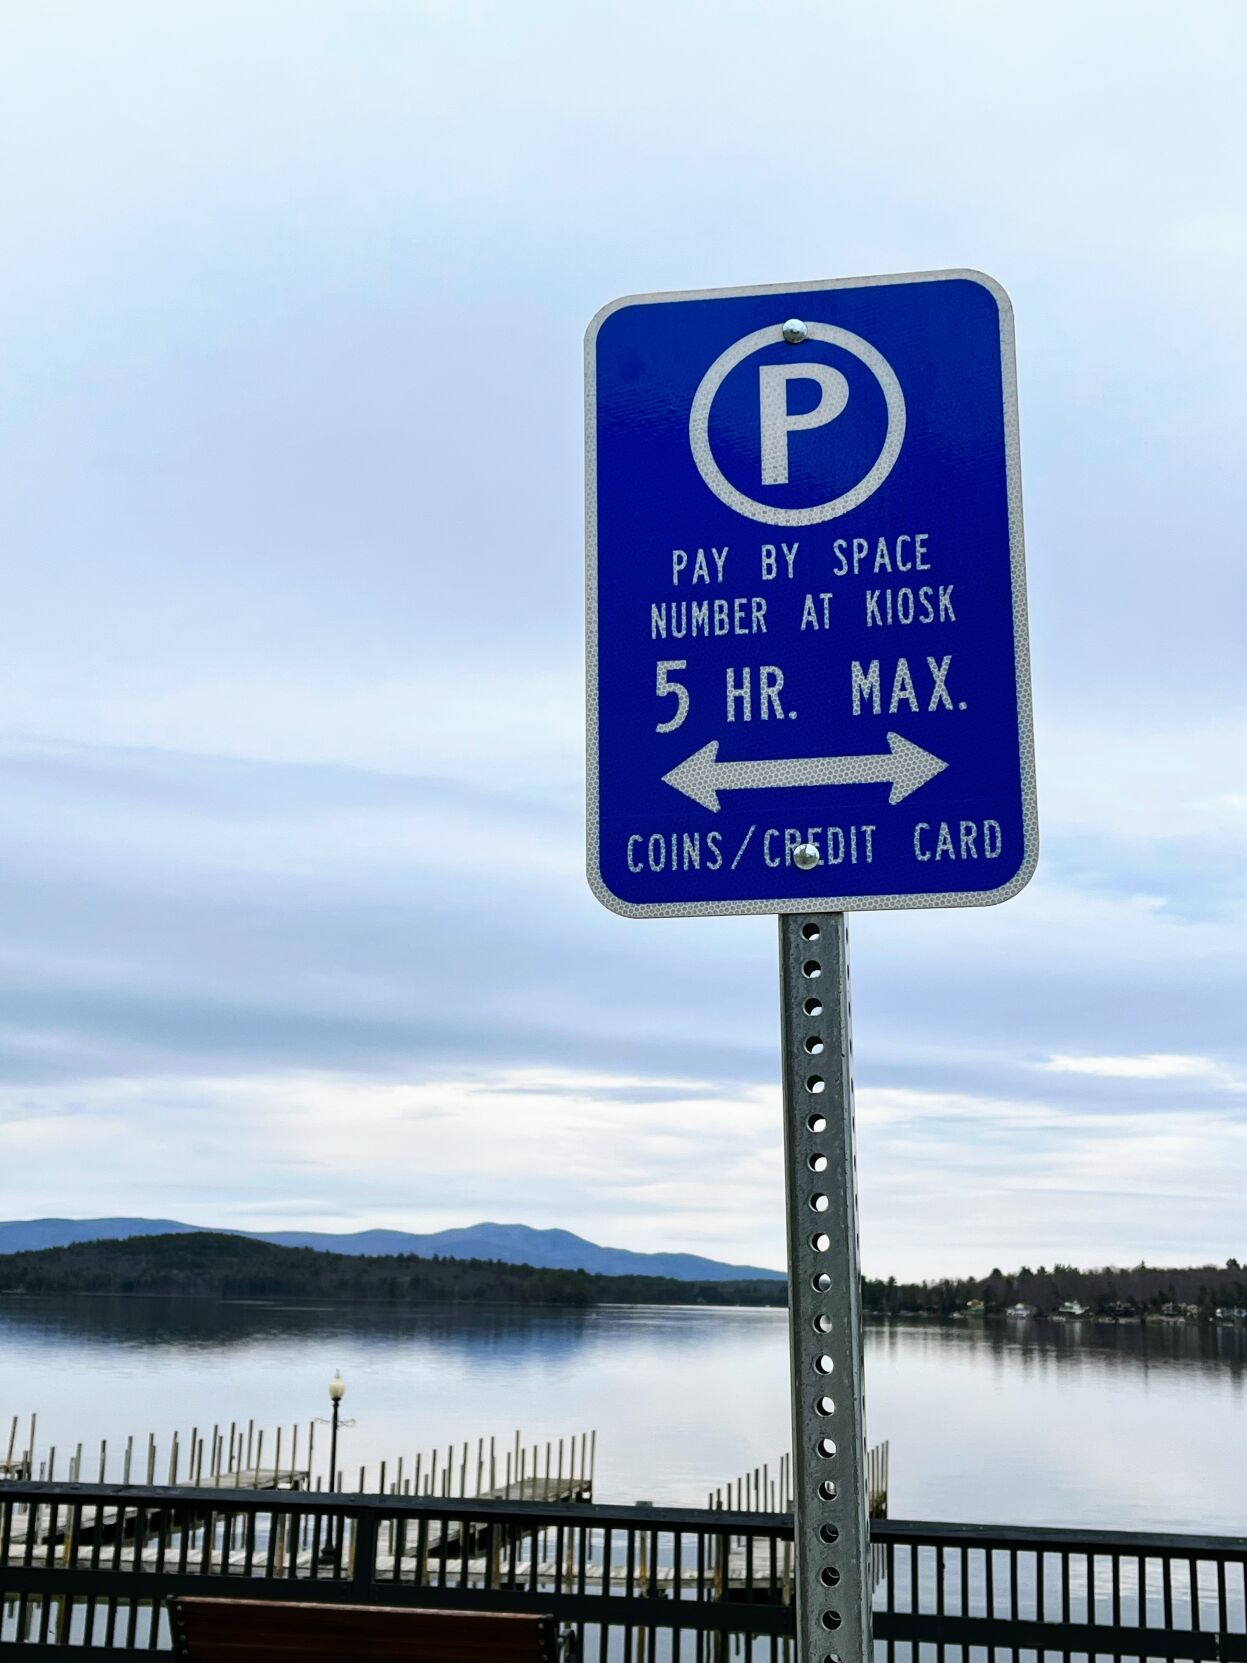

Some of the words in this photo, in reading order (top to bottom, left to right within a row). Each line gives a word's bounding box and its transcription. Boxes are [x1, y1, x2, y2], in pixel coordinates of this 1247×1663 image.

[759, 363, 849, 485] P
[671, 546, 730, 586] PAY
[760, 542, 799, 581] BY
[833, 534, 931, 577] SPACE
[650, 597, 768, 640] NUMBER
[800, 593, 833, 631] AT
[866, 585, 956, 627] KIOSK
[655, 660, 690, 733] 5
[726, 666, 798, 722] HR.
[851, 656, 968, 716] MAX.
[913, 820, 1002, 862] CARD
